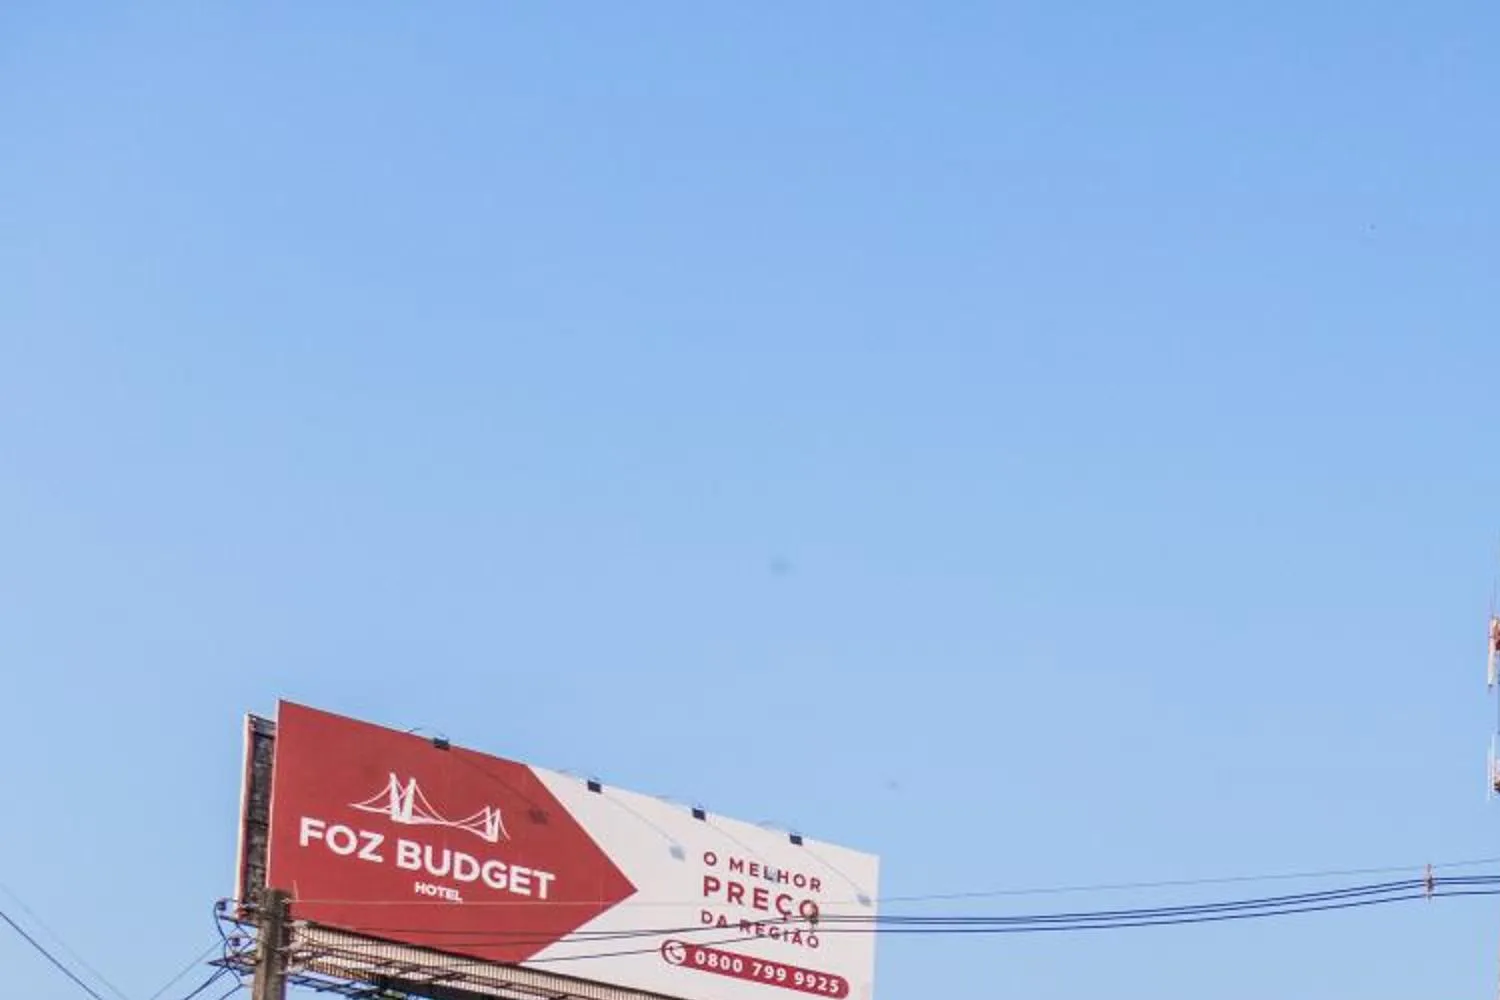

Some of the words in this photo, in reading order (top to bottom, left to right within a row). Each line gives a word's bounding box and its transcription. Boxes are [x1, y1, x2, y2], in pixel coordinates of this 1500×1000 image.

[299, 815, 385, 864] FOZ
[395, 837, 556, 900] BUDGET
[703, 851, 717, 867] O
[729, 856, 821, 893] MELHOR
[414, 881, 463, 903] HOTEL
[703, 875, 820, 921] PREÇO
[701, 909, 729, 929] DA
[739, 918, 820, 949] REGIÃO
[694, 951, 743, 974] 0800
[752, 962, 788, 982] 799
[794, 970, 840, 993] 9925
